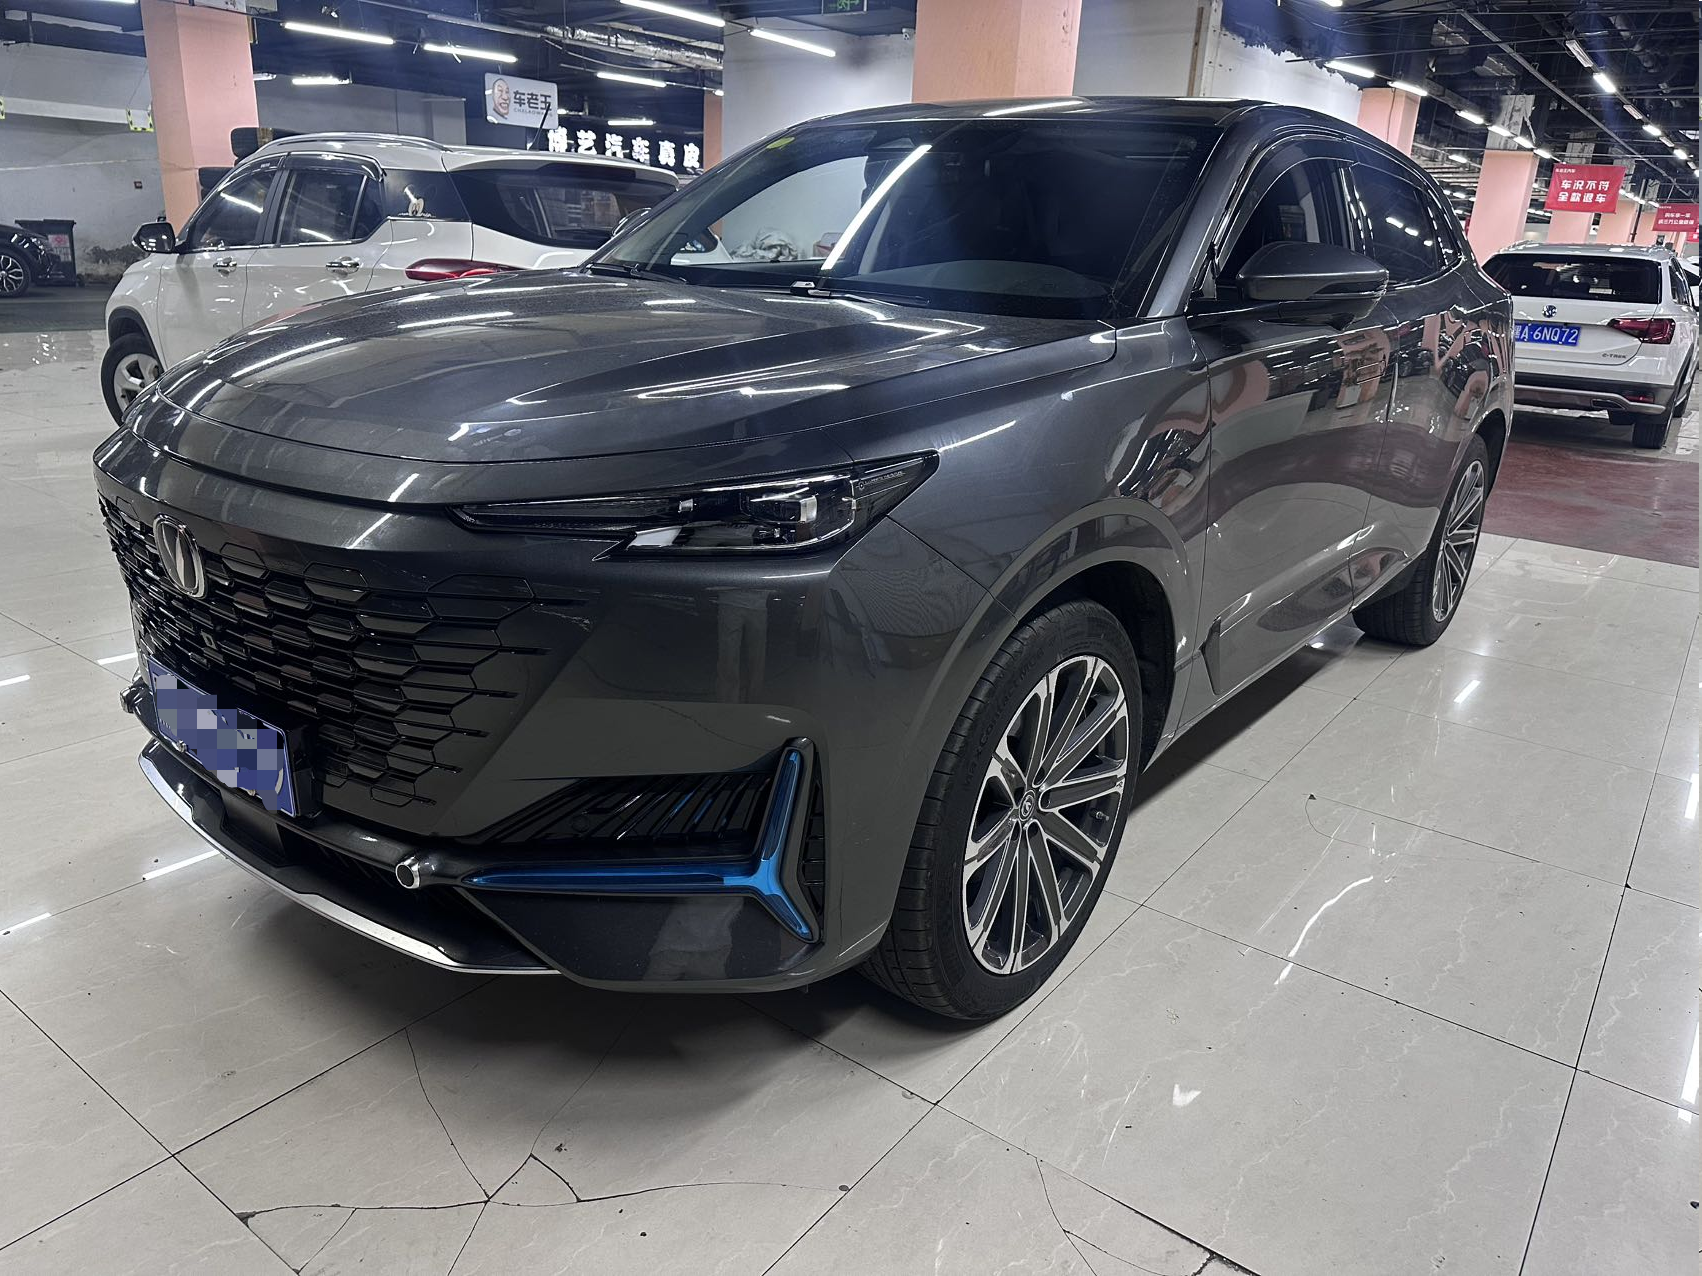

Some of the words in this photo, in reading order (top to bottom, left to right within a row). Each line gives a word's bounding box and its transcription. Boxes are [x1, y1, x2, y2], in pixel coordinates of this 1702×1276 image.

[513, 90, 551, 111] 车老王
[1561, 180, 1610, 191] 车况不符
[1557, 191, 1607, 203] 全款退车
